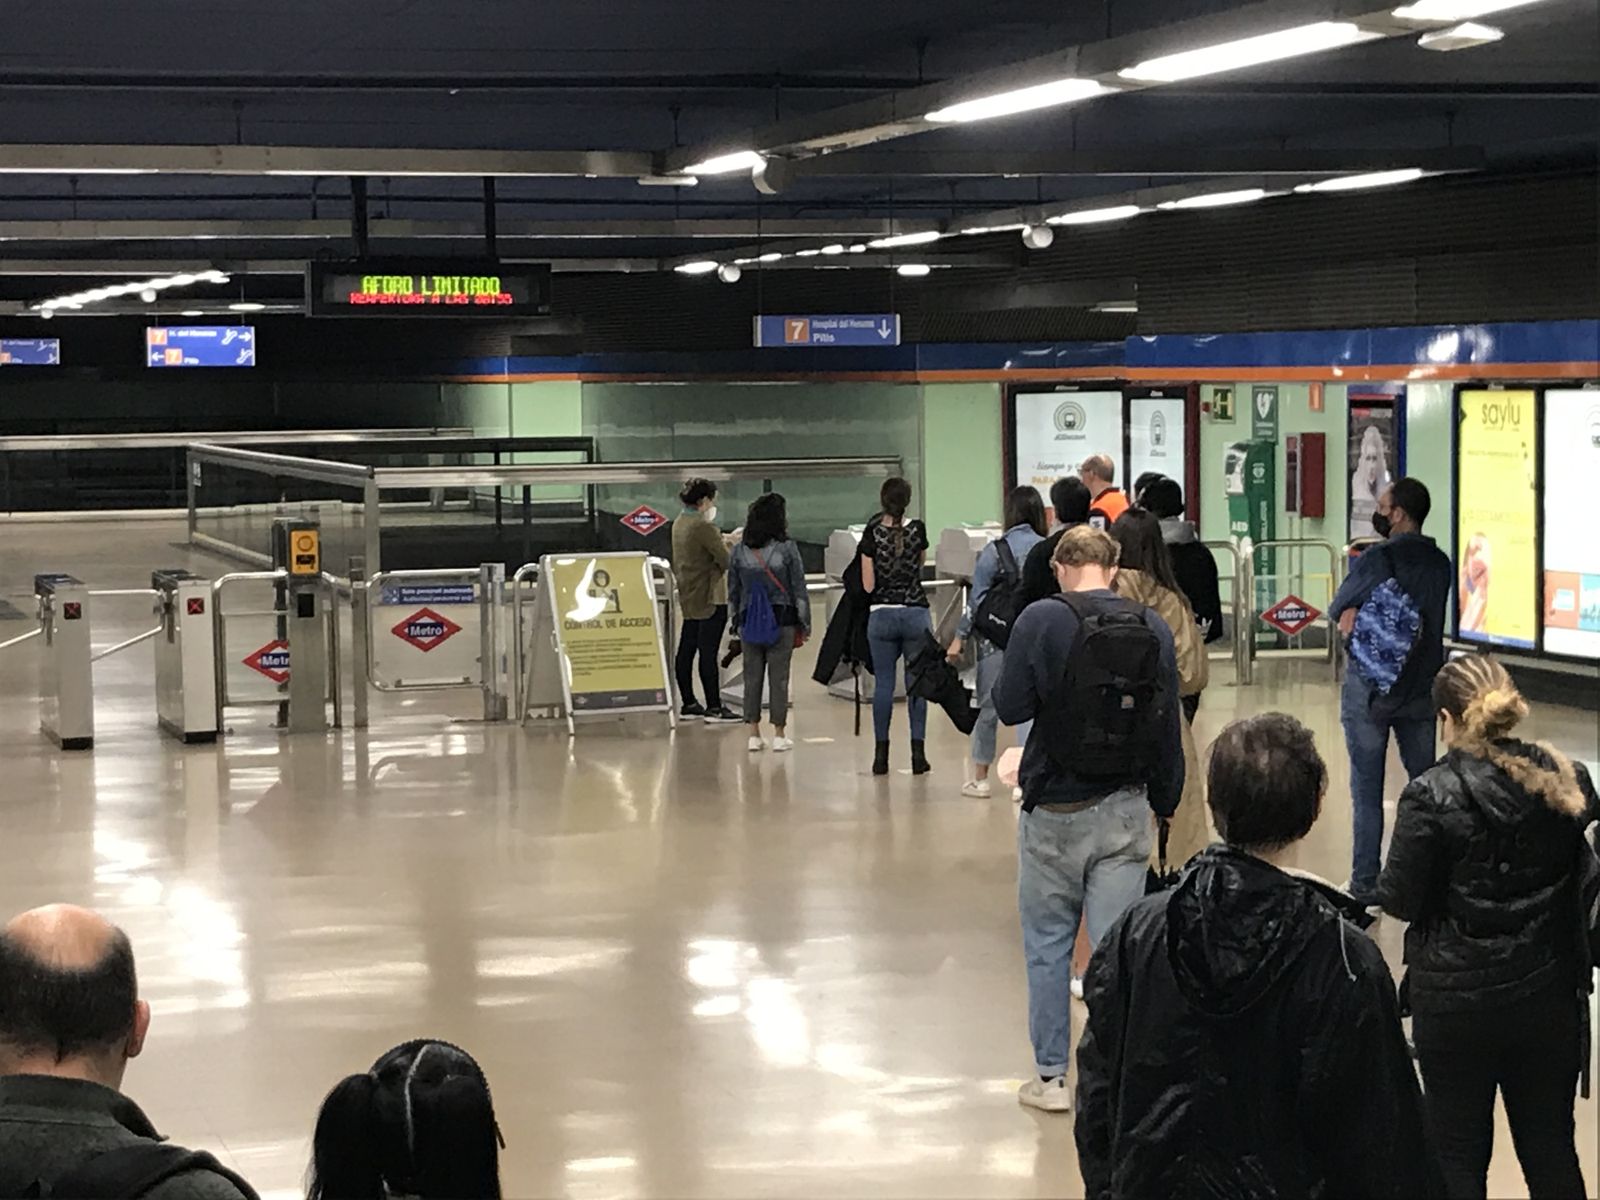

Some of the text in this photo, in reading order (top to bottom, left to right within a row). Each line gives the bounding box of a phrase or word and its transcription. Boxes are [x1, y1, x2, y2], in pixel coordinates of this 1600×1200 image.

[362, 275, 501, 295] AFORO LIMITADO
[791, 321, 804, 340] 7
[1481, 397, 1521, 431] saylu
[1278, 610, 1306, 619] Metro
[564, 617, 652, 630] CONTROL DE ACCESO
[410, 626, 442, 636] Metro
[262, 655, 289, 666] Metr
